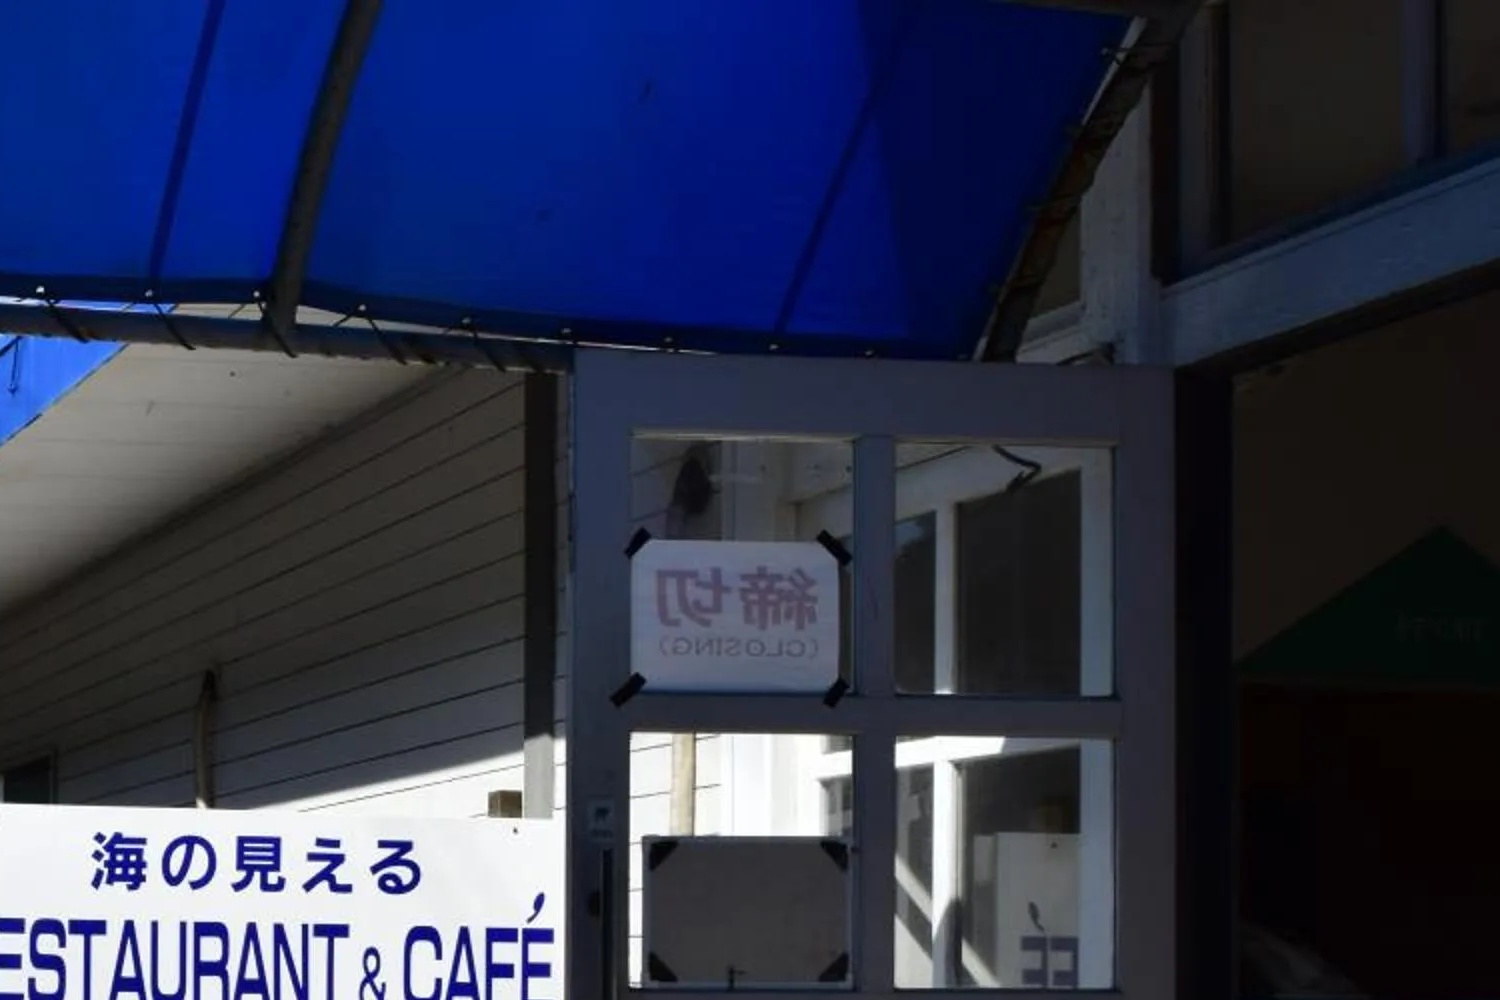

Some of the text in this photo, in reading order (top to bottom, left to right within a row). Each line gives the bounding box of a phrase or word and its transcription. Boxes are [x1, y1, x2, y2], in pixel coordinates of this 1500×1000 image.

[91, 832, 422, 895] 海の見える
